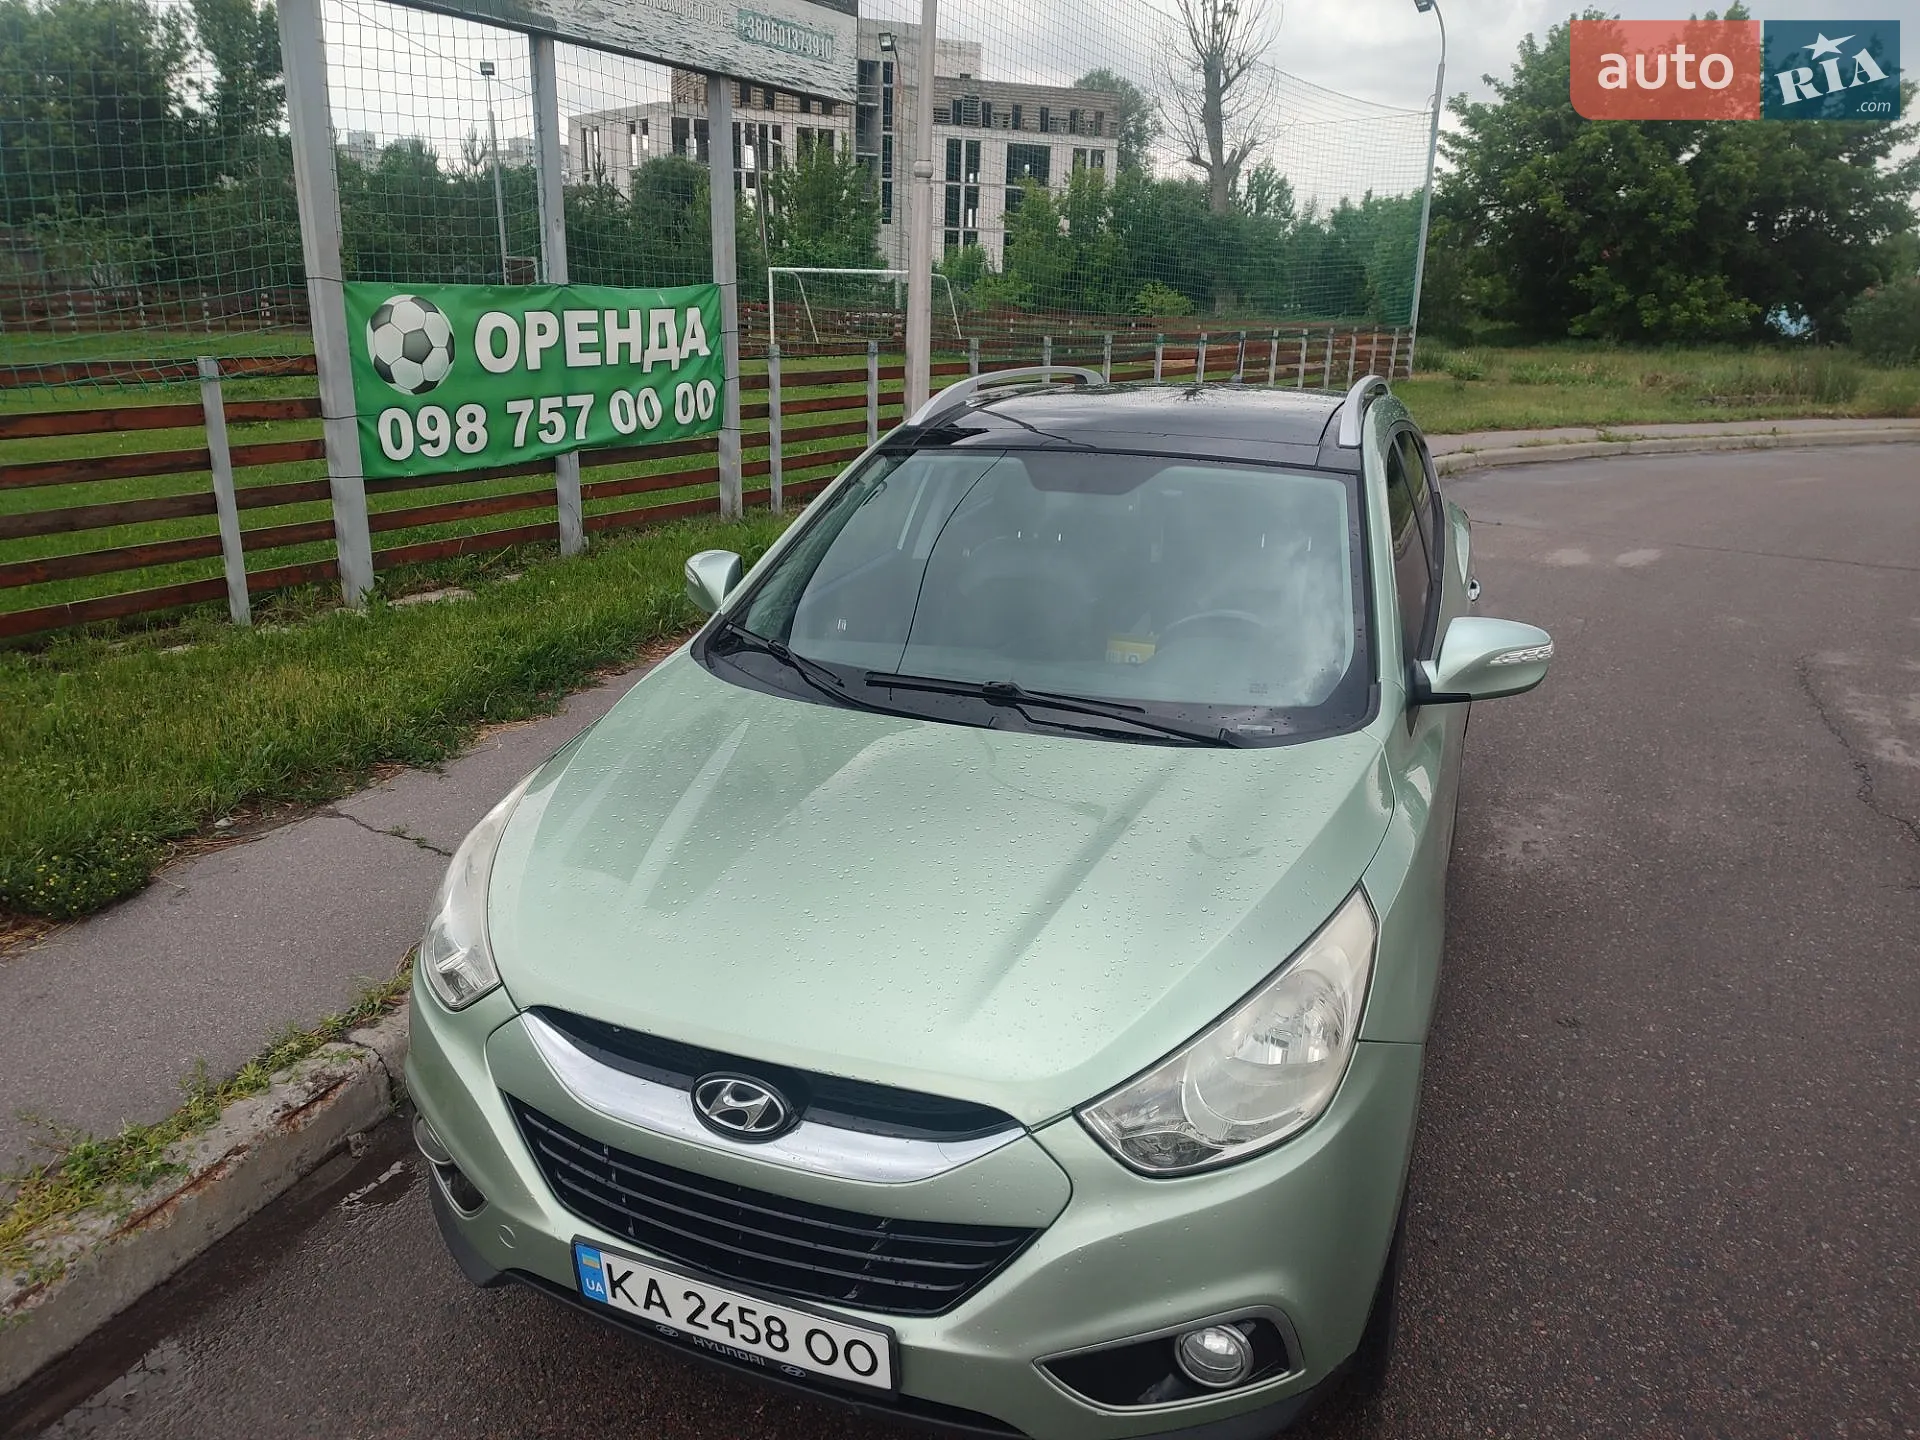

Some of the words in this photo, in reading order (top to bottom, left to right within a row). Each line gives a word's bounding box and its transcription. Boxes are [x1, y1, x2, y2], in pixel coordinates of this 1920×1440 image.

[741, 16, 832, 60] +380501373910
[474, 306, 711, 373] ОРЕНДА
[377, 403, 489, 461] 098
[506, 394, 594, 448] 757
[609, 387, 663, 435] 00
[674, 379, 716, 425] 00
[585, 1277, 605, 1295] UA
[606, 1263, 672, 1318] KA
[682, 1290, 790, 1353] 2458
[692, 1336, 766, 1367] HYUNDAI
